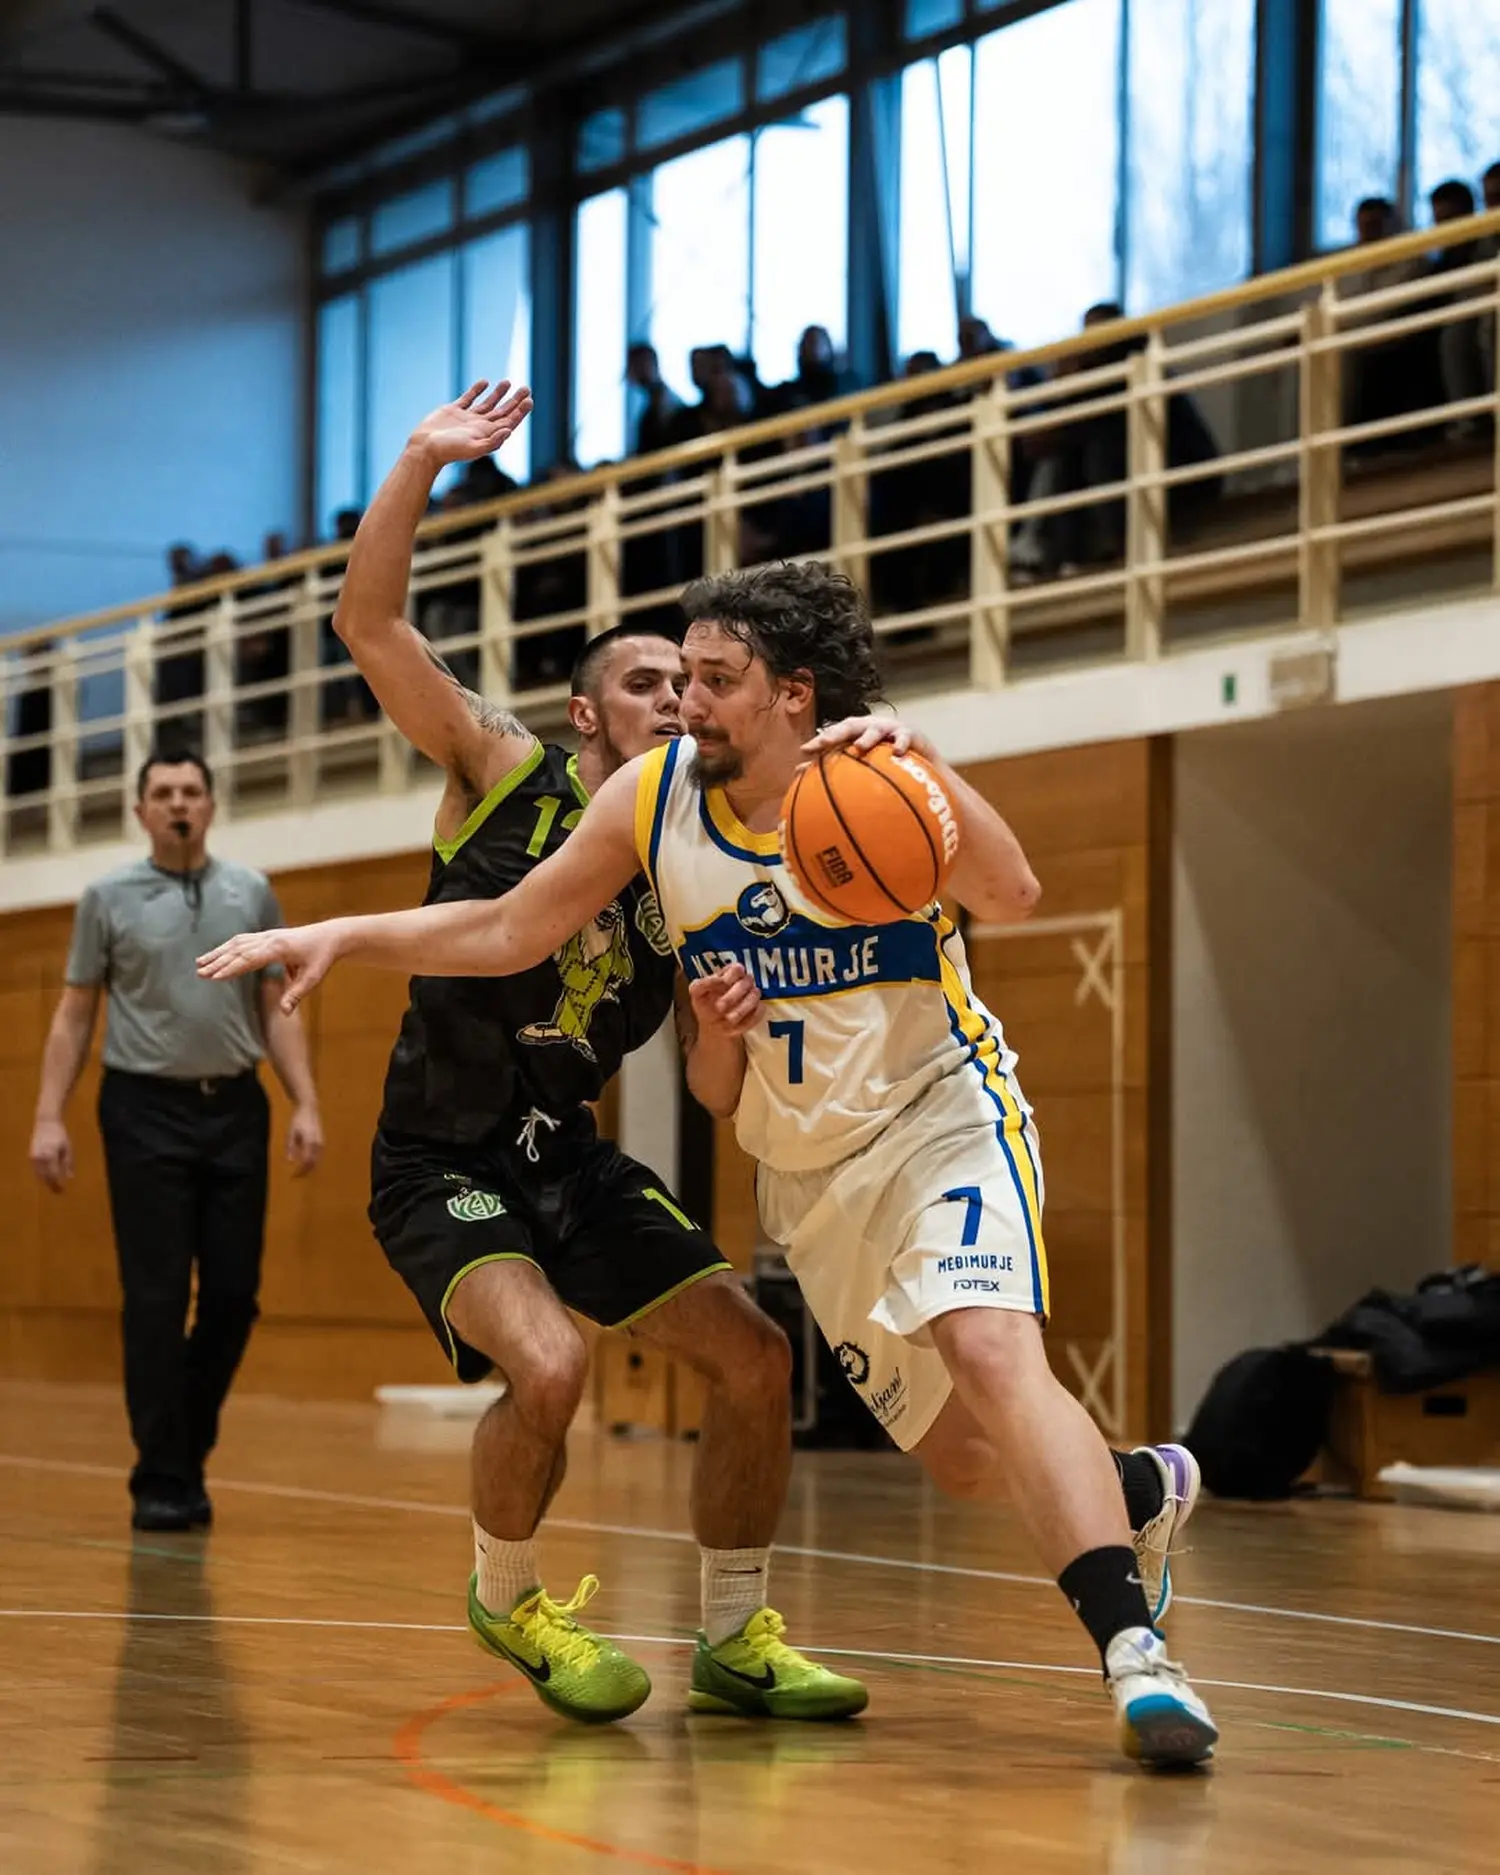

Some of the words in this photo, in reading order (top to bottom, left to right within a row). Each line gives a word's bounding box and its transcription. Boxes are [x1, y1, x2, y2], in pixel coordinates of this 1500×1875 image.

[526, 795, 585, 858] 1
[768, 1020, 804, 1084] 7
[941, 1186, 983, 1246] 7
[953, 1279, 1000, 1292] FOTEX
